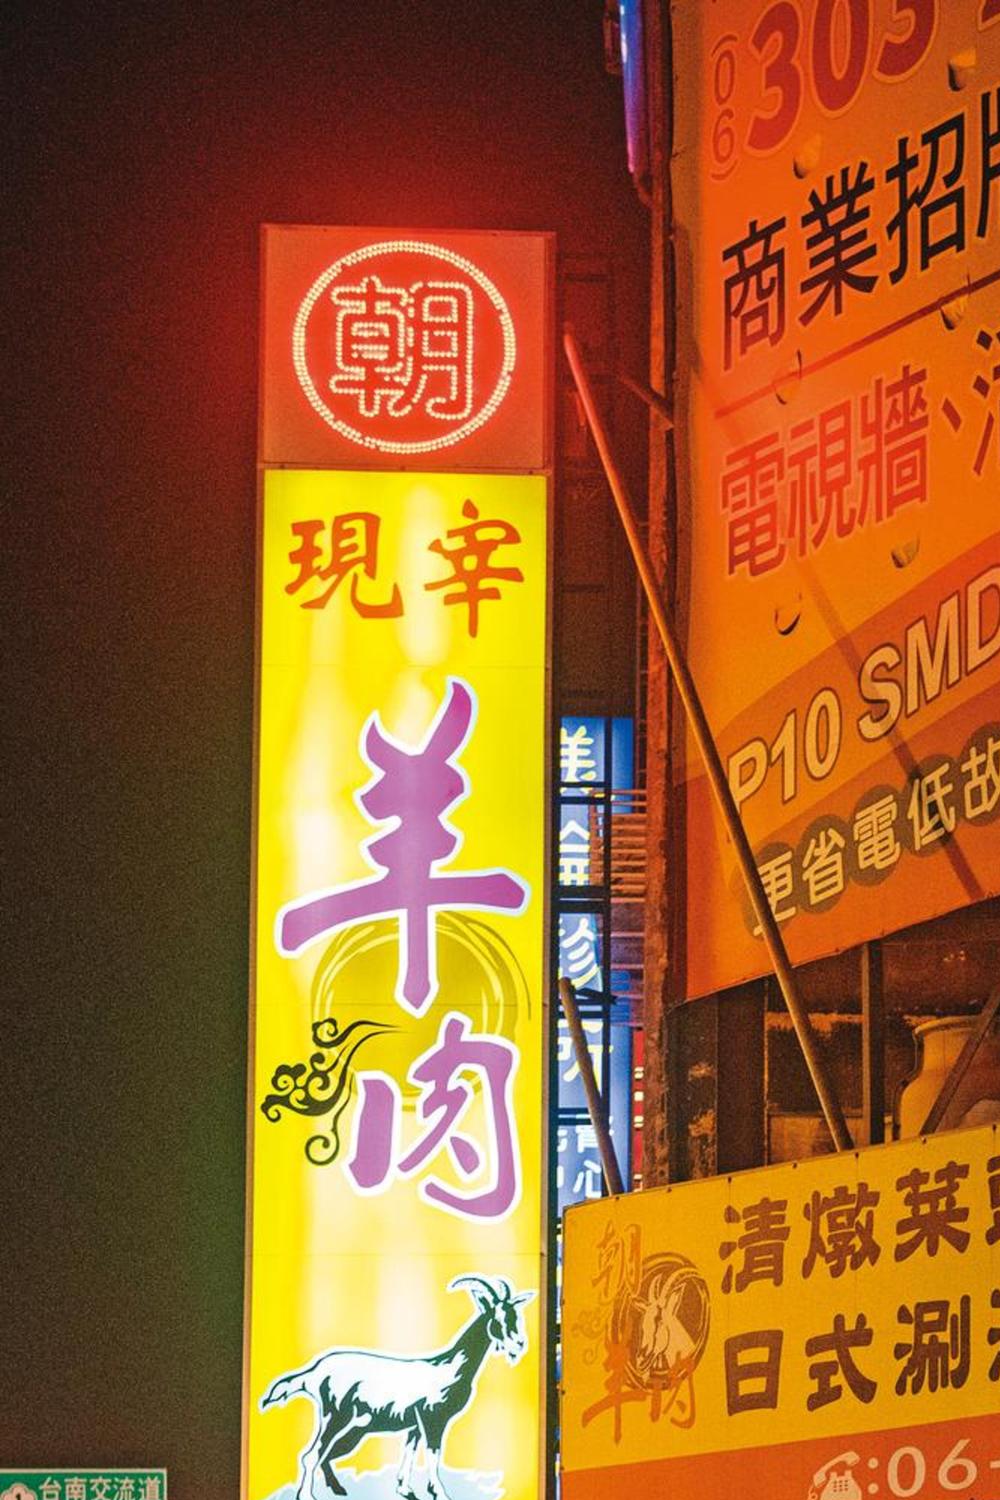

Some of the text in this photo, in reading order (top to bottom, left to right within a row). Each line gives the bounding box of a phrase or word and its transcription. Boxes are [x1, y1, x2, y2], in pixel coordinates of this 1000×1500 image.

[285, 500, 525, 637] 現宰
[728, 690, 841, 814] P10
[276, 674, 533, 1222] 羊肉
